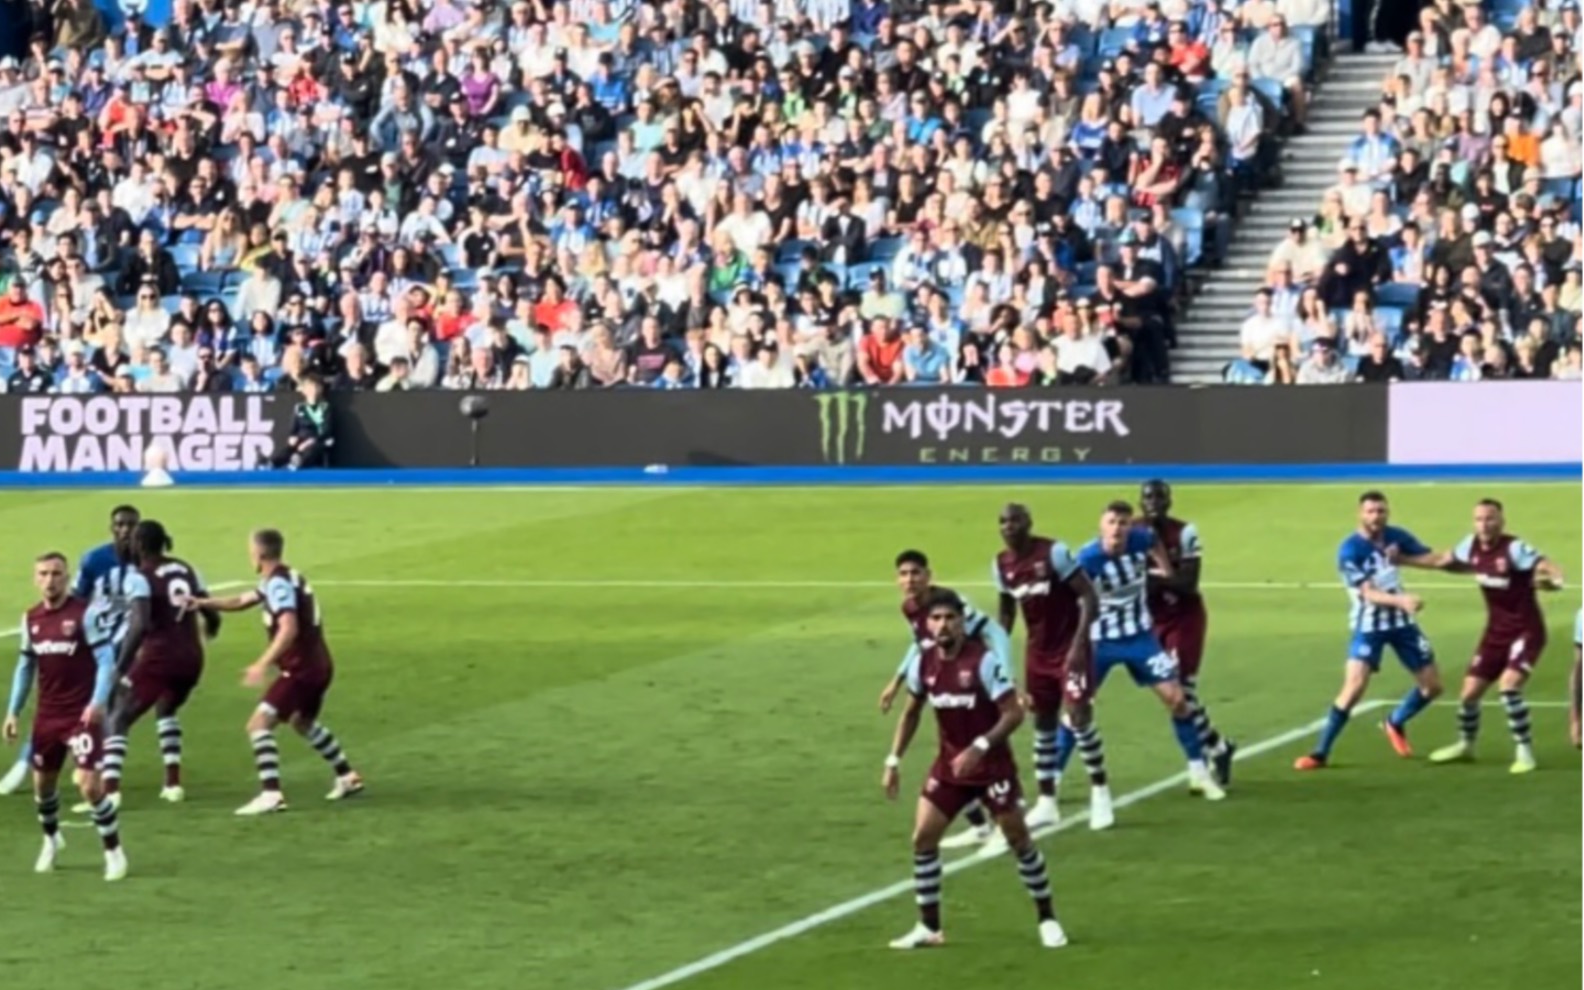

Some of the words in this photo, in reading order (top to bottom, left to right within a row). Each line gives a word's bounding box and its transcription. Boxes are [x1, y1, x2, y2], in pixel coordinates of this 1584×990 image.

[21, 397, 273, 435] FOOTBALL
[882, 394, 1130, 440] MONSTER
[919, 447, 1092, 463] ENERGY
